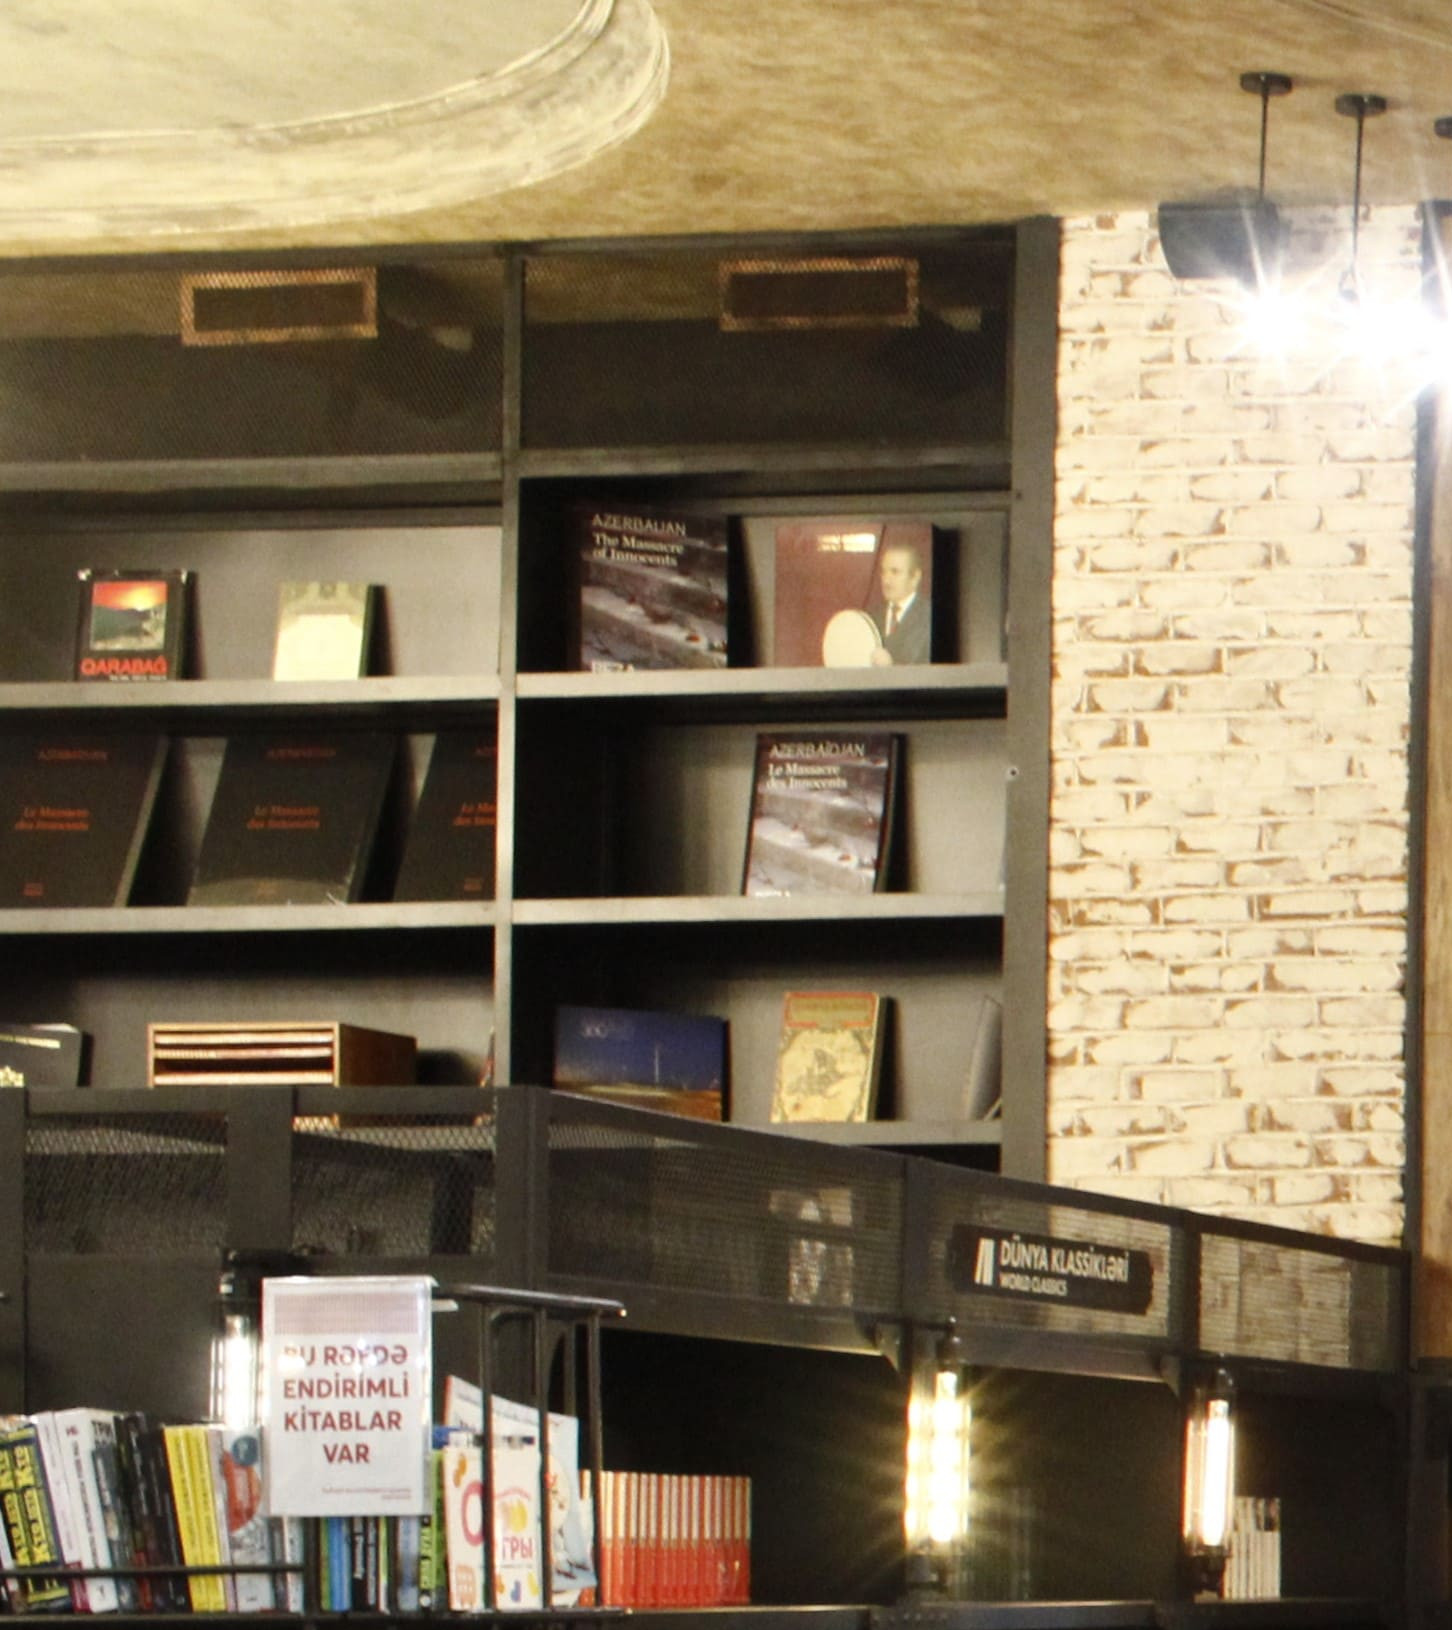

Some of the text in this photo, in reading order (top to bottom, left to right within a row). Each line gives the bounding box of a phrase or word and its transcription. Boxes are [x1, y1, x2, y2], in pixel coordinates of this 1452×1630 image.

[593, 532, 685, 555] The Massacre
[610, 547, 679, 567] Innocents
[80, 655, 168, 676] QARABAĞ
[784, 764, 841, 777] Massacre
[789, 778, 847, 790] Innocents
[1000, 1234, 1047, 1270] DÜNYA
[283, 1371, 409, 1399] ENDİRİMLİ
[284, 1404, 402, 1432] KİTABLAR
[323, 1443, 370, 1464] VAR
